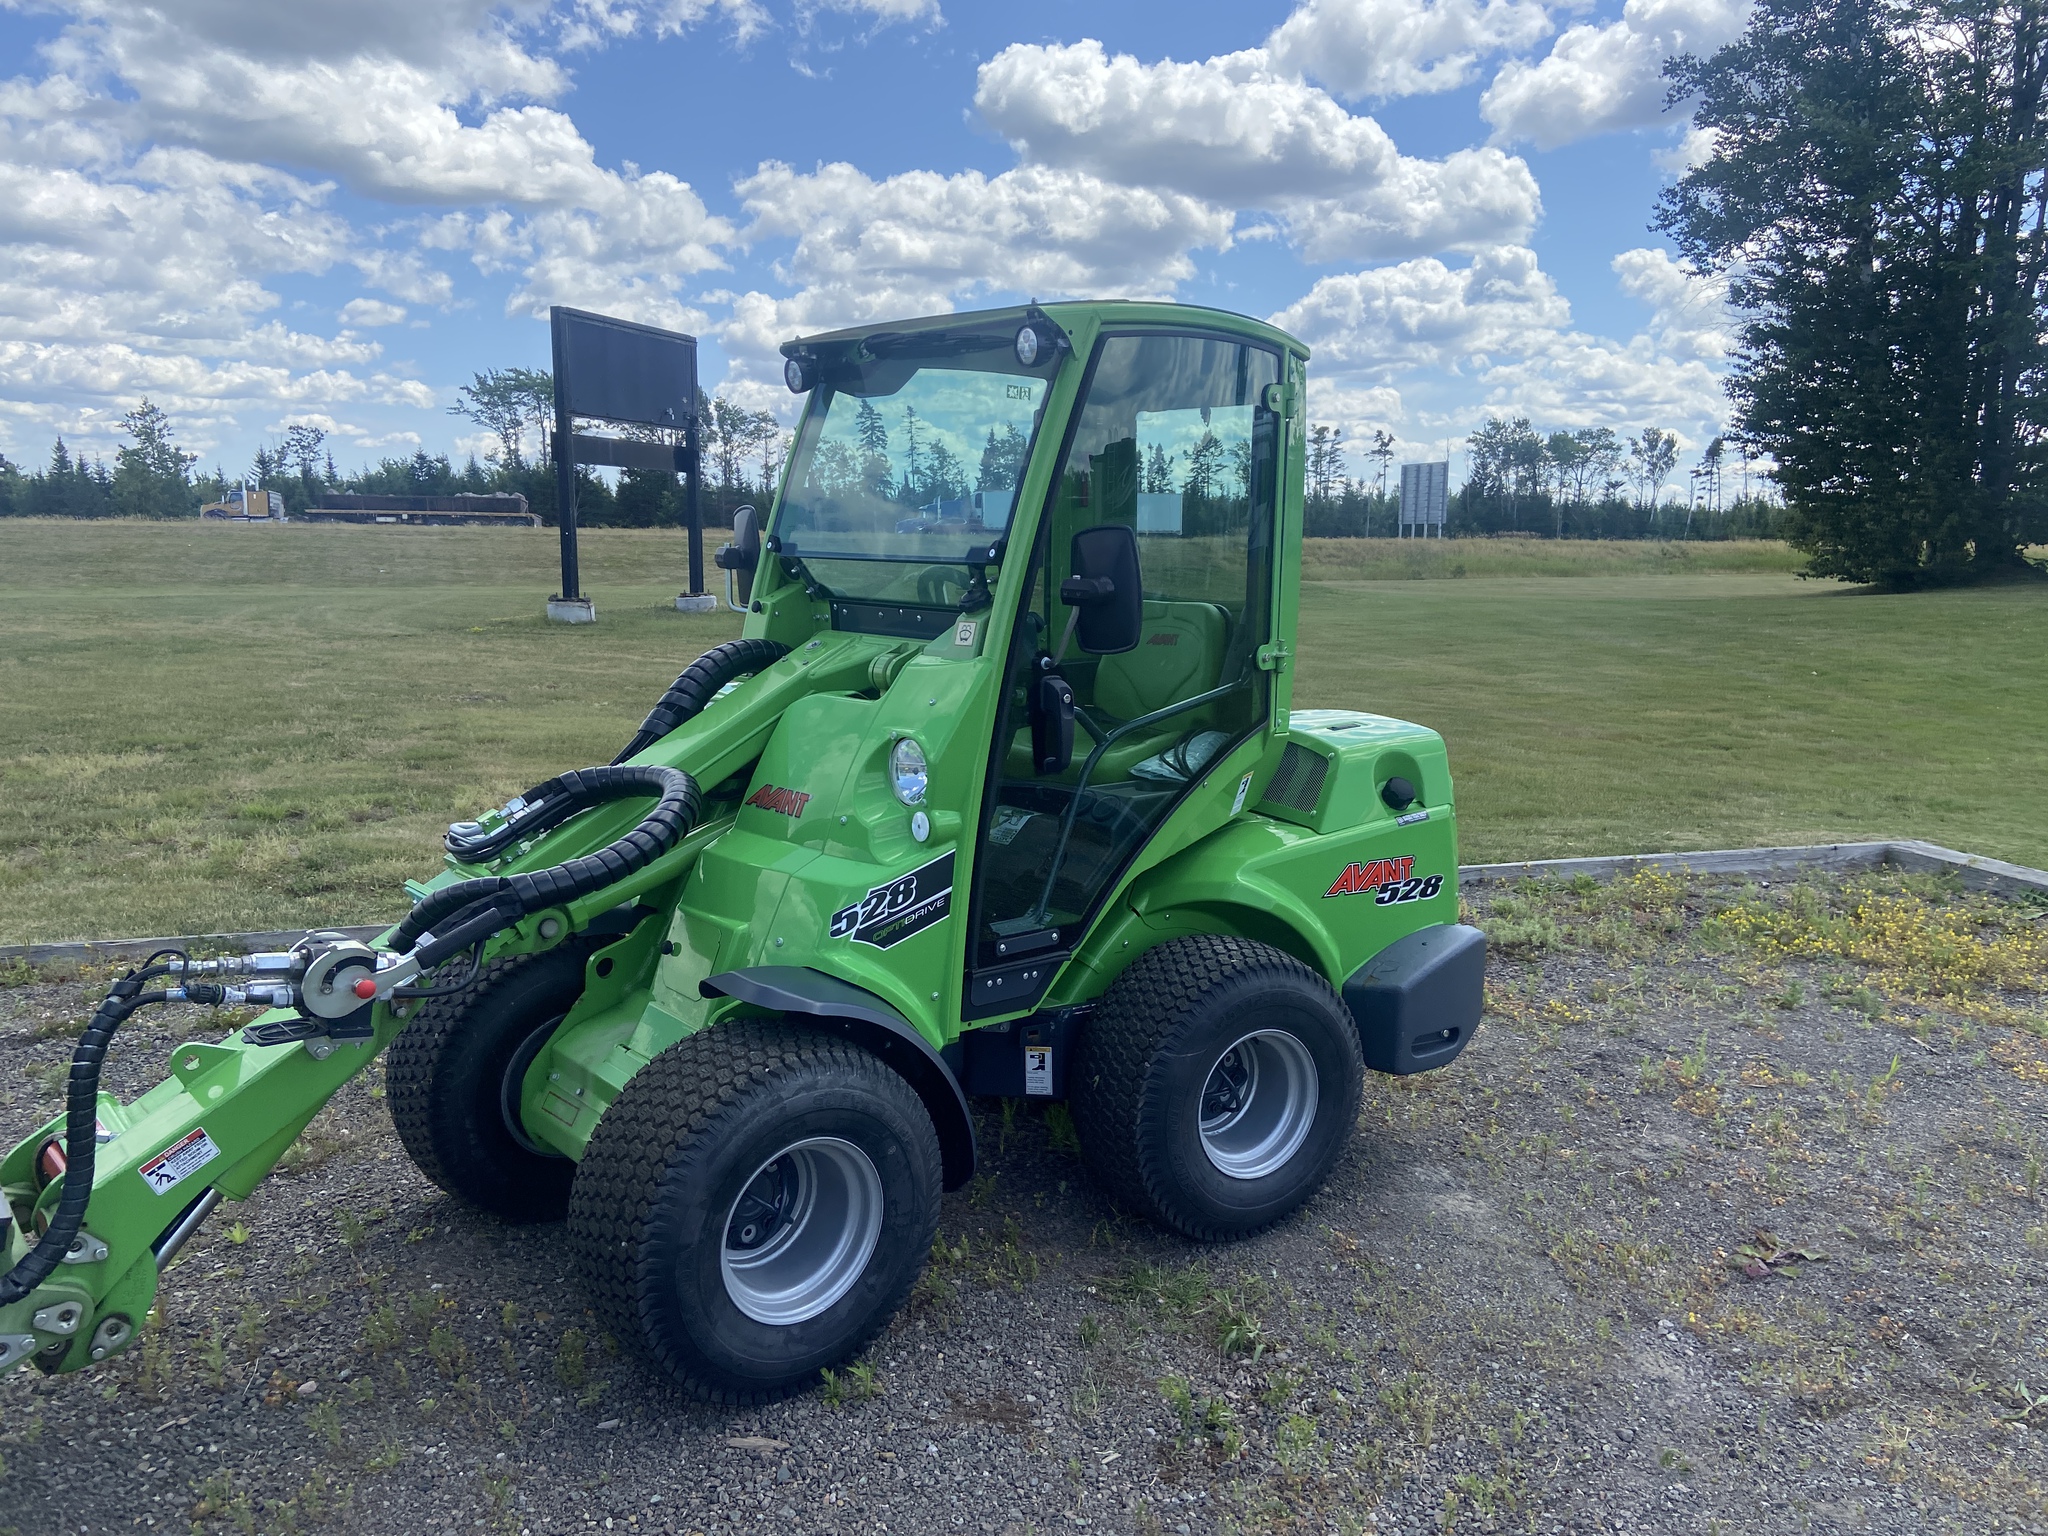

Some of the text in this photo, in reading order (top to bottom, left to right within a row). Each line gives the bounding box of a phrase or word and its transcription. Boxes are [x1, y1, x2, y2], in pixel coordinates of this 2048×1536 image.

[745, 783, 811, 818] AVANT
[1321, 855, 1415, 898] AVANT
[1374, 873, 1444, 906] 528
[829, 876, 917, 938] 528
[163, 1138, 190, 1158] DANGER
